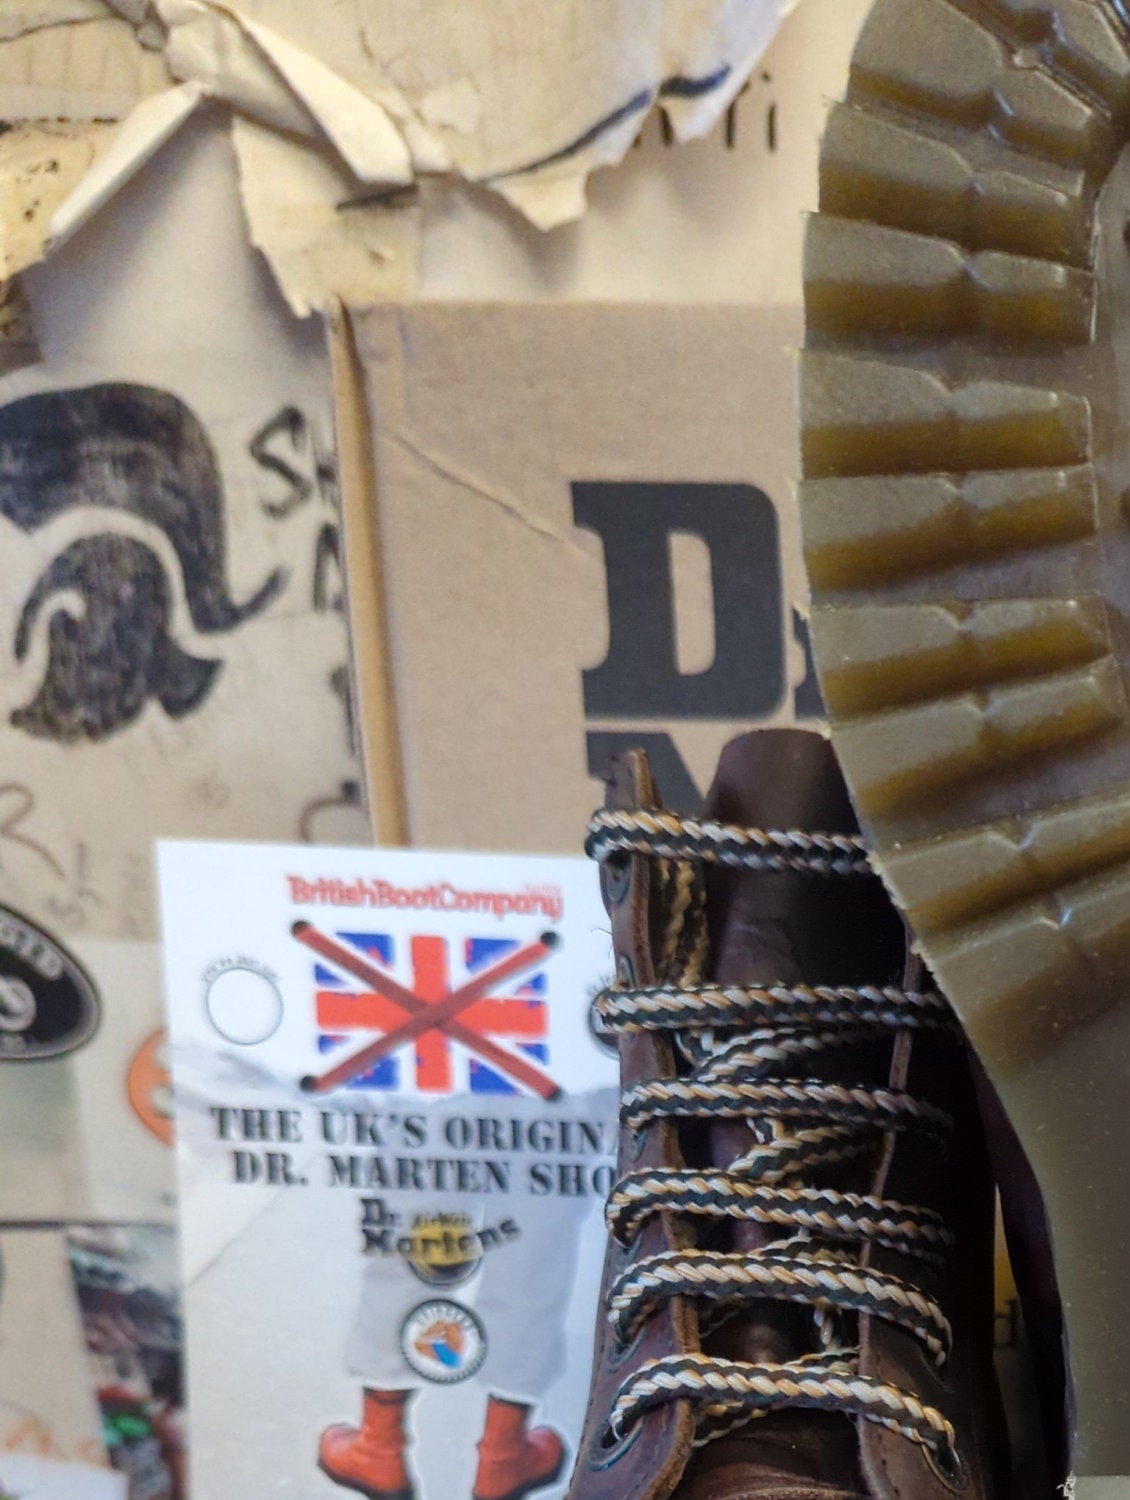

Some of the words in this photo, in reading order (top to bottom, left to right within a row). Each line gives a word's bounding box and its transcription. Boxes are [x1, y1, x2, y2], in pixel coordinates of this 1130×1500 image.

[211, 1107, 303, 1142] THE
[320, 1111, 428, 1149] UK'S
[445, 1117, 618, 1156] ORIGIN
[231, 1150, 308, 1186] DR.
[328, 1155, 510, 1195] MARTEN
[529, 1163, 615, 1198] SHO
[362, 1219, 522, 1257] Martens
